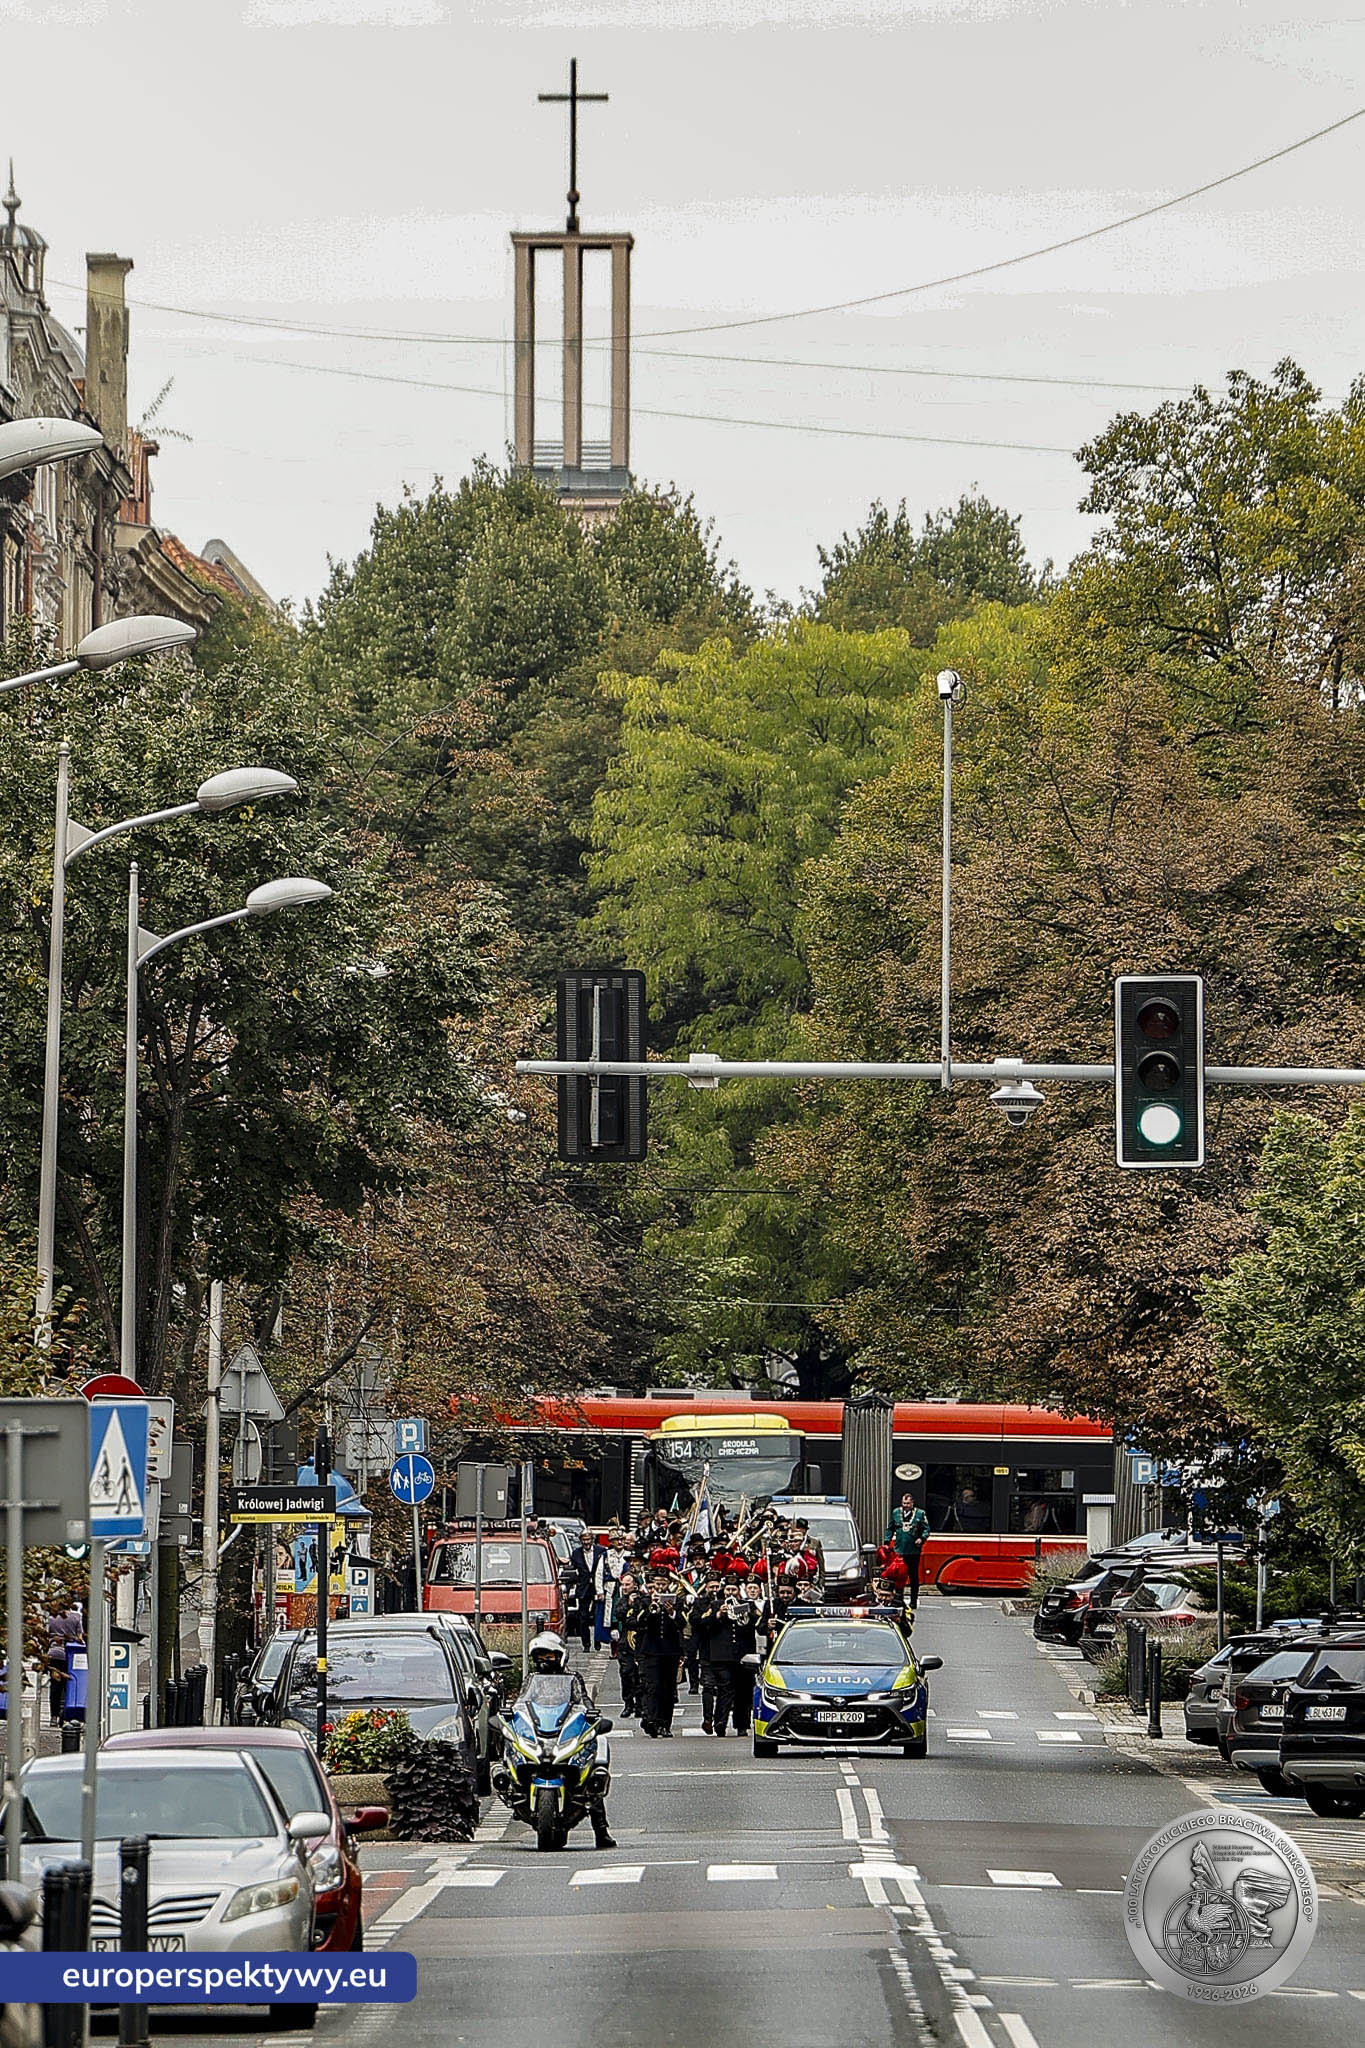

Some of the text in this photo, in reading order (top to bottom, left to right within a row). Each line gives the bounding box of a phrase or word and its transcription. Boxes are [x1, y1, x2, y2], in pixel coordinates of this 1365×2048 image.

[402, 1423, 418, 1449] P
[671, 1441, 692, 1458] 154
[722, 1440, 756, 1448] ŚRODULA
[718, 1448, 760, 1456] CHEMICZNA
[1137, 1461, 1152, 1481] P
[238, 1498, 325, 1511] Królowej Jadwigi
[354, 1570, 368, 1585] P
[355, 1603, 364, 1611] A
[110, 1646, 127, 1667] P
[807, 1676, 872, 1685] POLICJA
[110, 1695, 121, 1706] A
[819, 1712, 863, 1721] HPP K209
